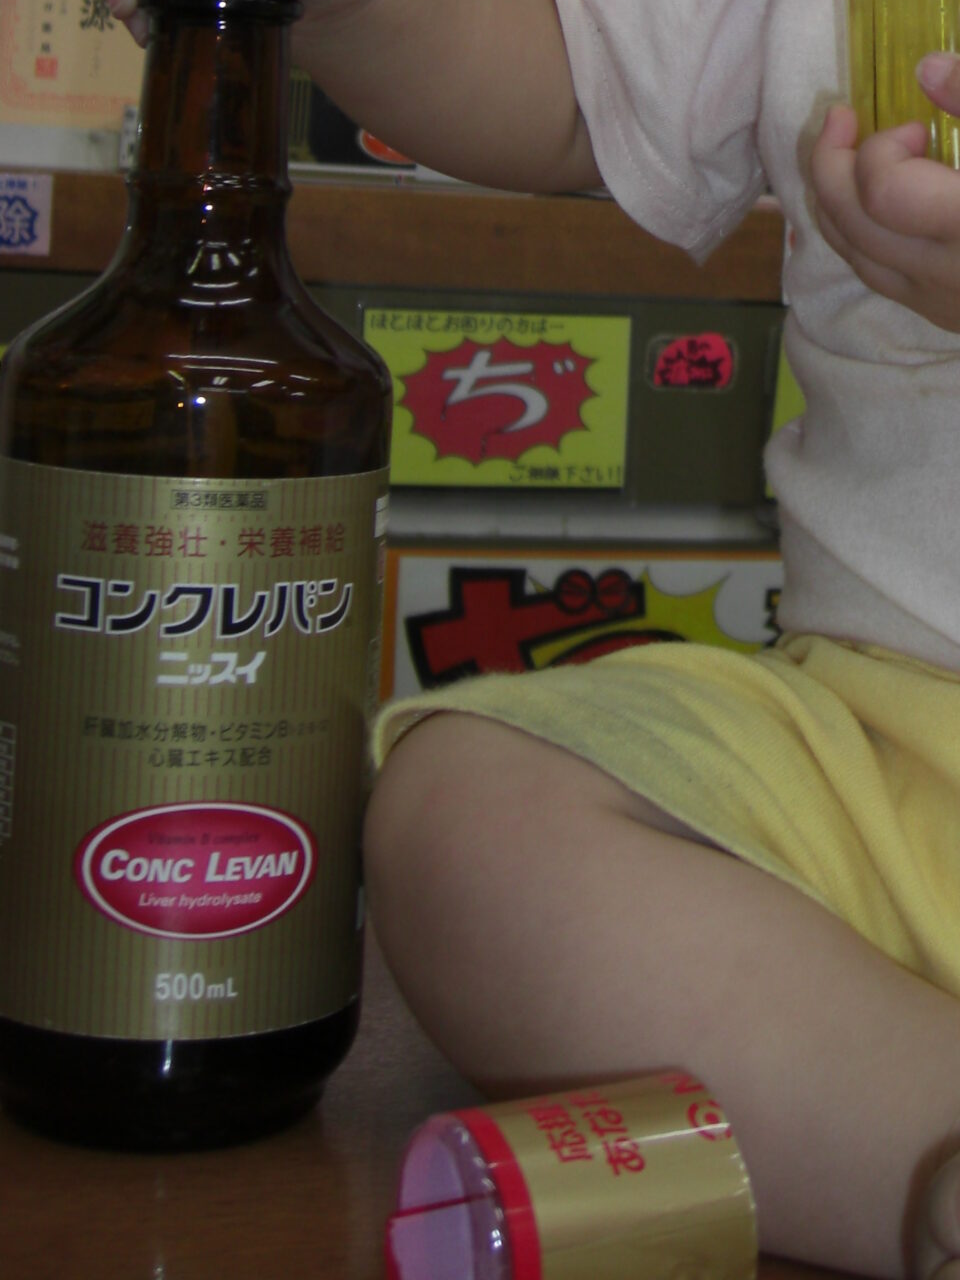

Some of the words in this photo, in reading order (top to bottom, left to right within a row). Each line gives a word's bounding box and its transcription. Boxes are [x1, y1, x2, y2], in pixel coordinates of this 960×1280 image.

[173, 491, 267, 510] 第3類医薬品
[80, 522, 347, 559] 滋養強壮・栄養補給
[156, 650, 268, 686] ニッスイ
[148, 745, 273, 769] 心臓エキス配合
[138, 891, 176, 908] Liver
[178, 889, 264, 909] hydrolysate
[154, 973, 238, 1002] 500mL
